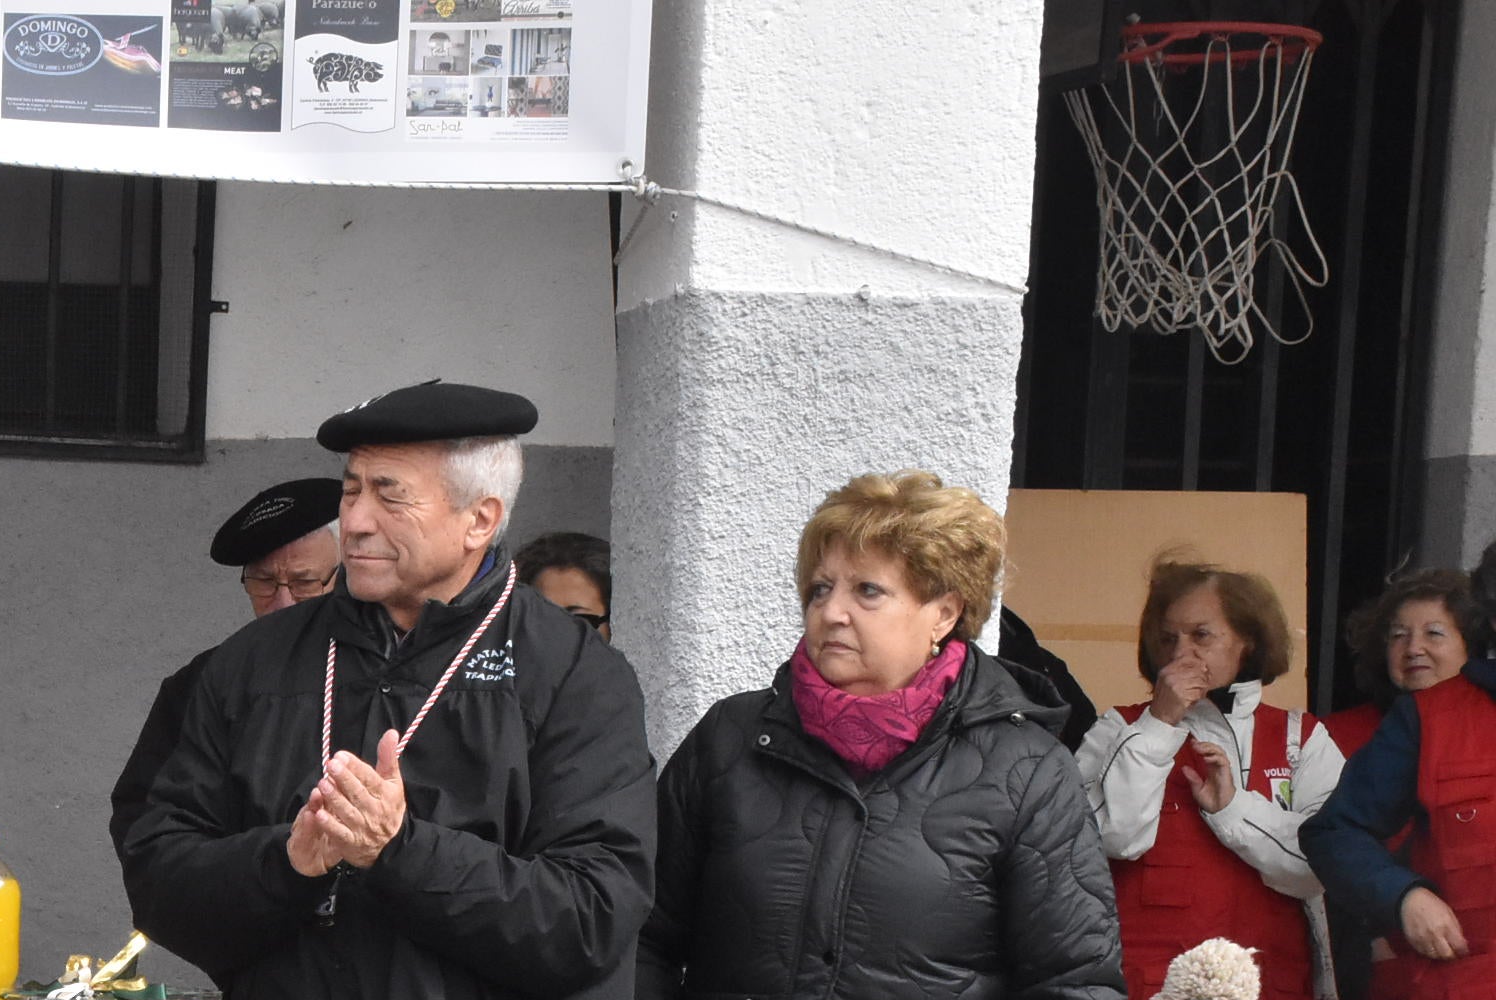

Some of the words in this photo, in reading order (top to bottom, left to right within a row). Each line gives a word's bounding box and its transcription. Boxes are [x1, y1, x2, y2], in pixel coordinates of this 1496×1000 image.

[17, 20, 89, 39] DOMINGO
[47, 34, 61, 47] D
[223, 66, 246, 75] MEAT
